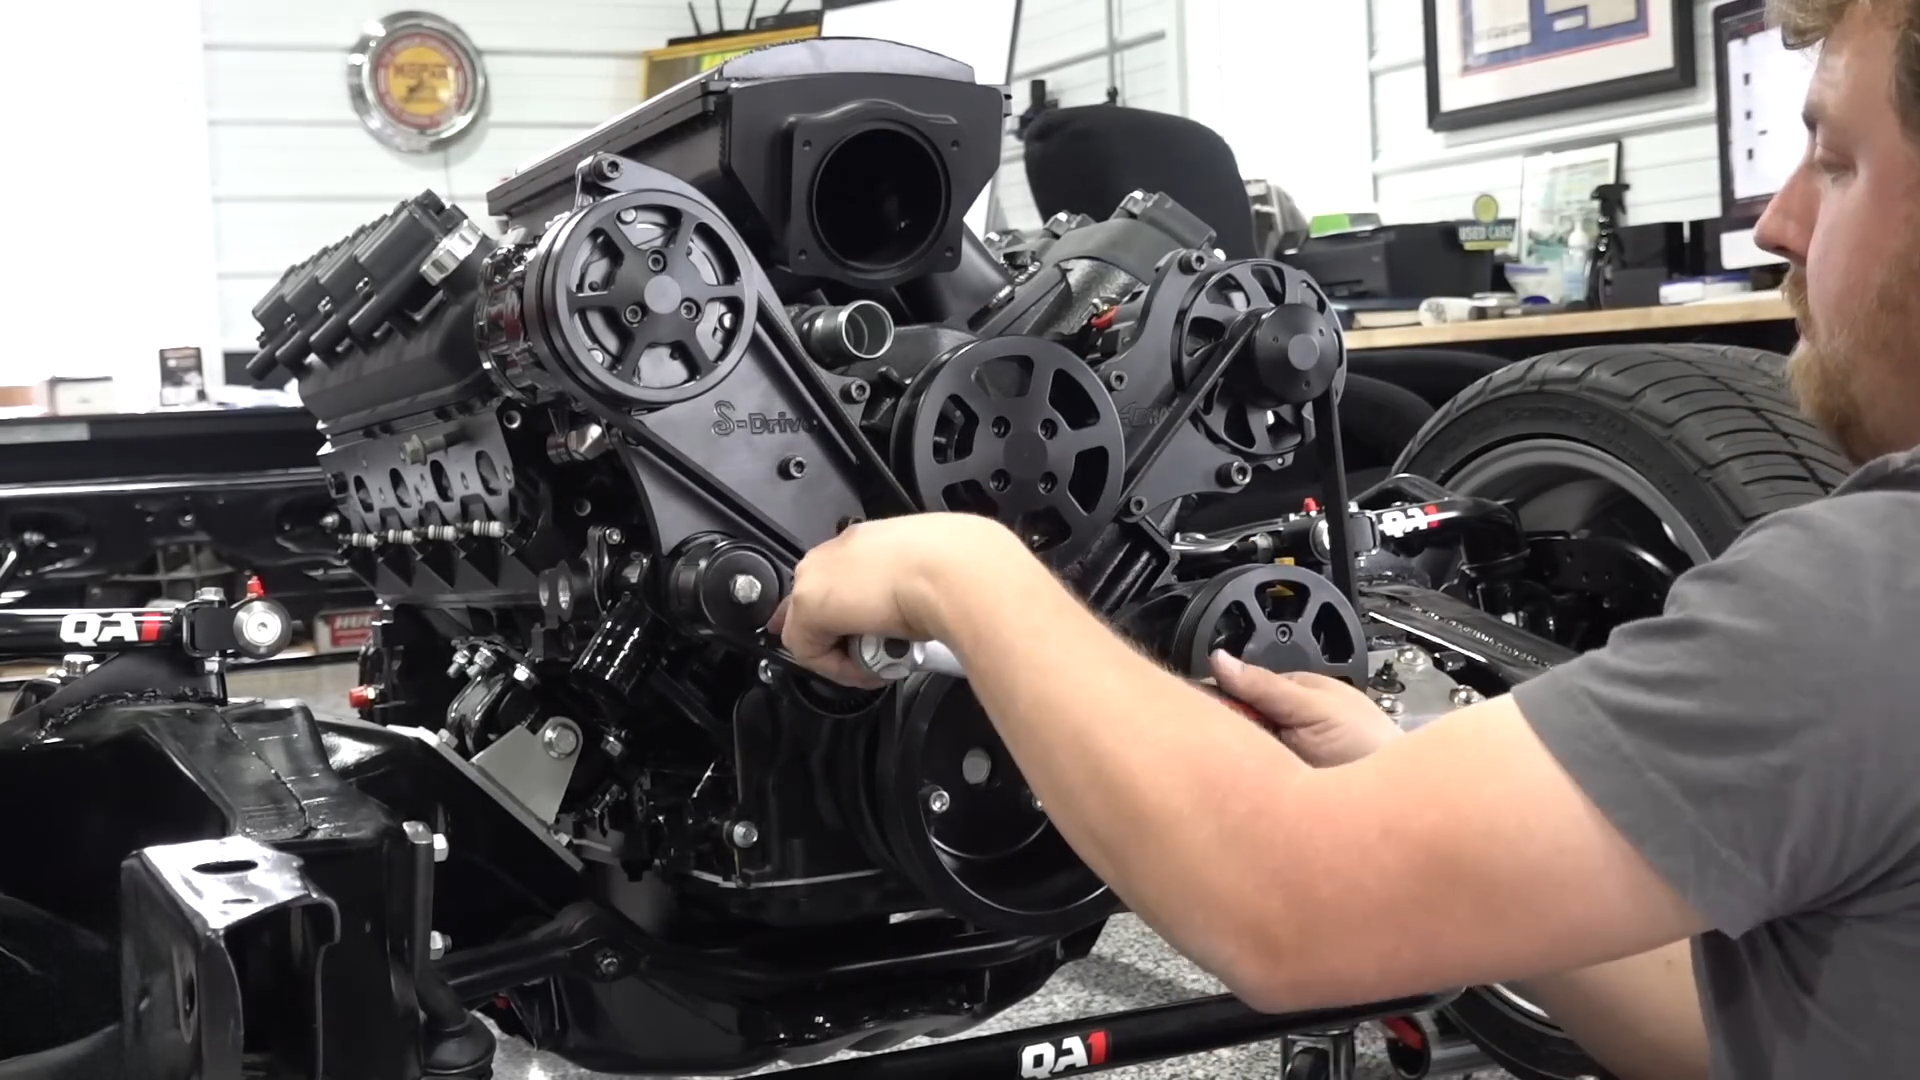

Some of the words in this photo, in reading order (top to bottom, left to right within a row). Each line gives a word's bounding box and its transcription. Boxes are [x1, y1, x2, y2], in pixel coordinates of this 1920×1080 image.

[1459, 226, 1486, 241] USED
[1487, 224, 1513, 240] CARS
[1382, 504, 1439, 538] QA1
[60, 612, 161, 647] QA1
[1021, 1031, 1106, 1079] QA1
